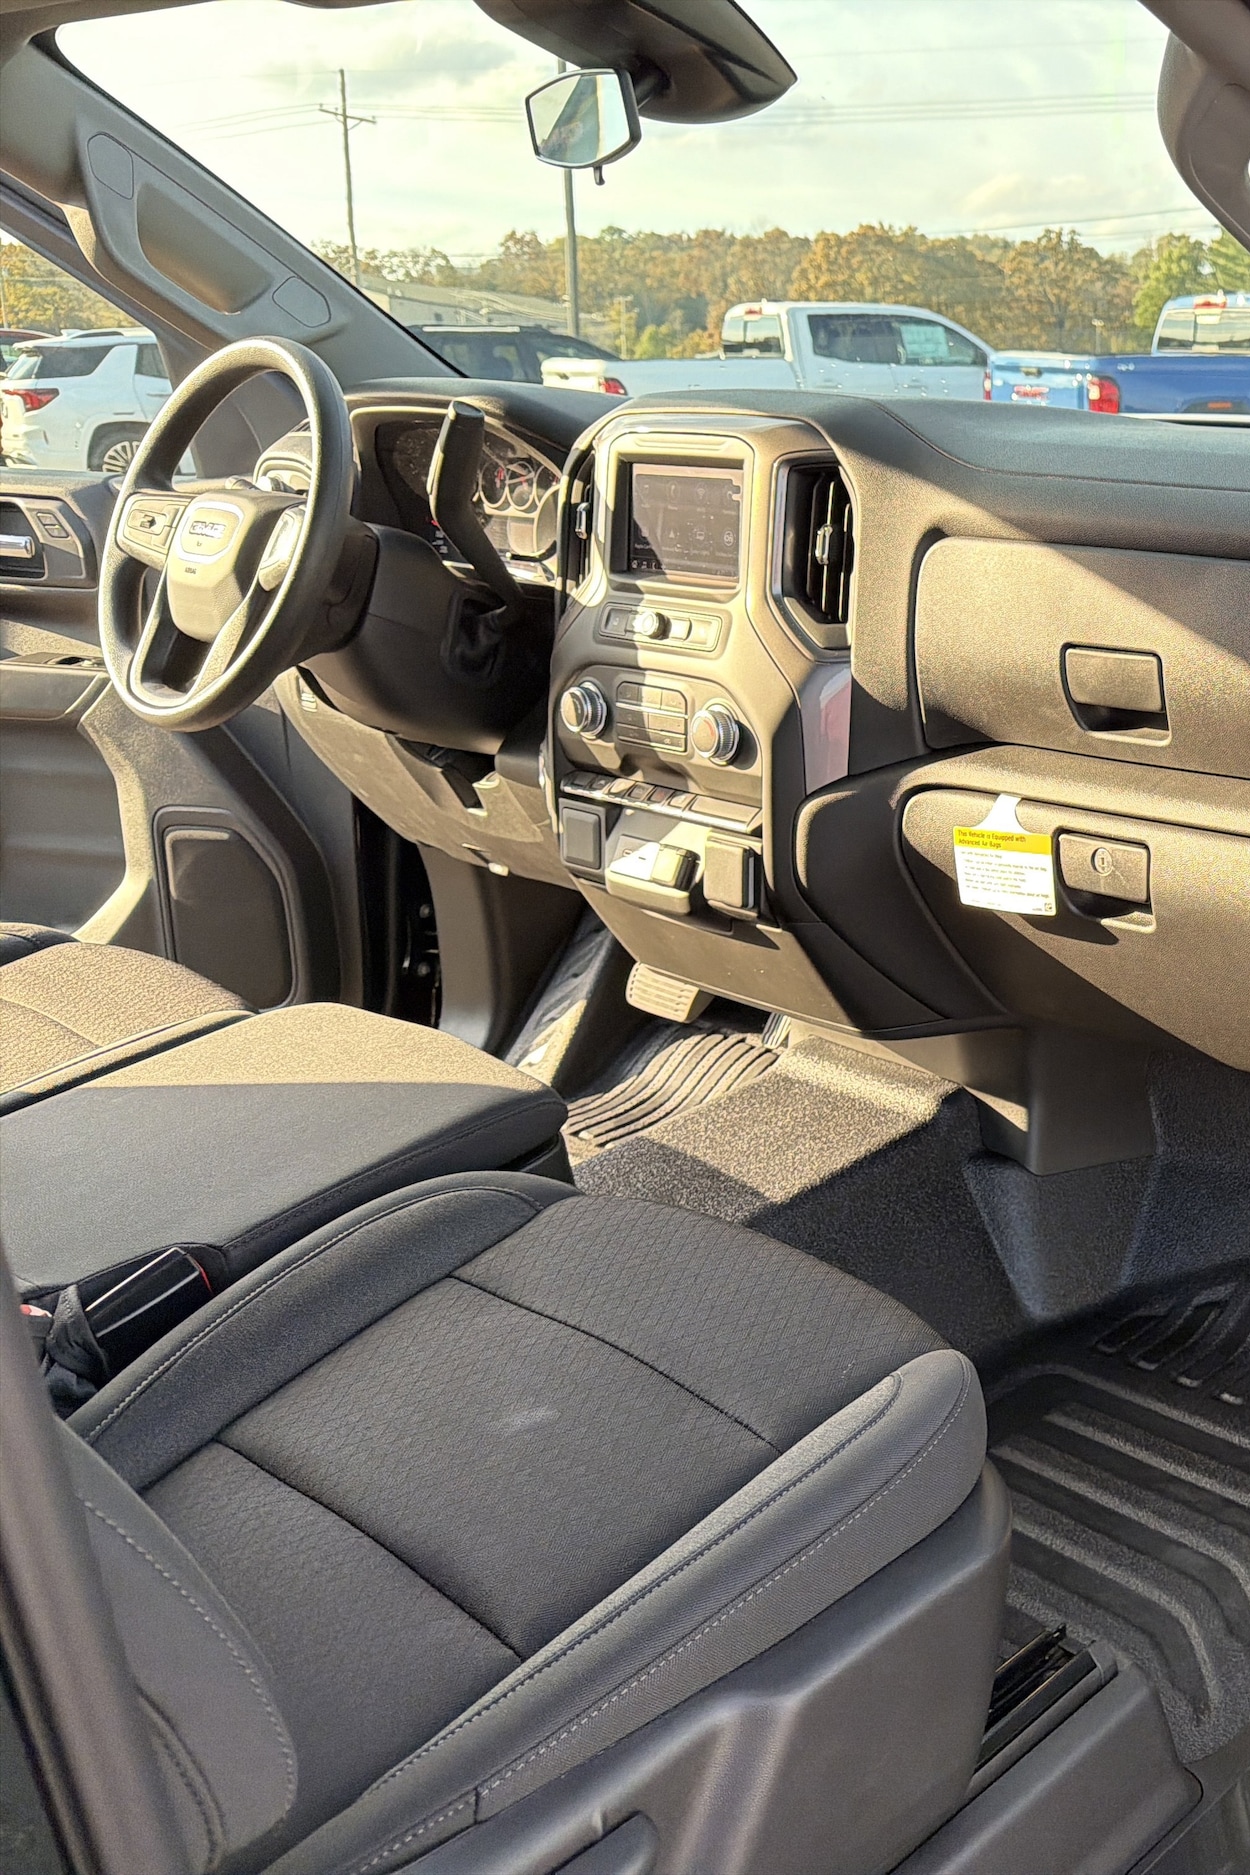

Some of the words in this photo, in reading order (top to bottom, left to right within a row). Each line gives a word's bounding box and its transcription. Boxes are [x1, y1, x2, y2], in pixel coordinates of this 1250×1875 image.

[969, 831, 985, 839] Vehicle
[992, 833, 1014, 842] Equipped
[958, 838, 980, 846] Advanced
